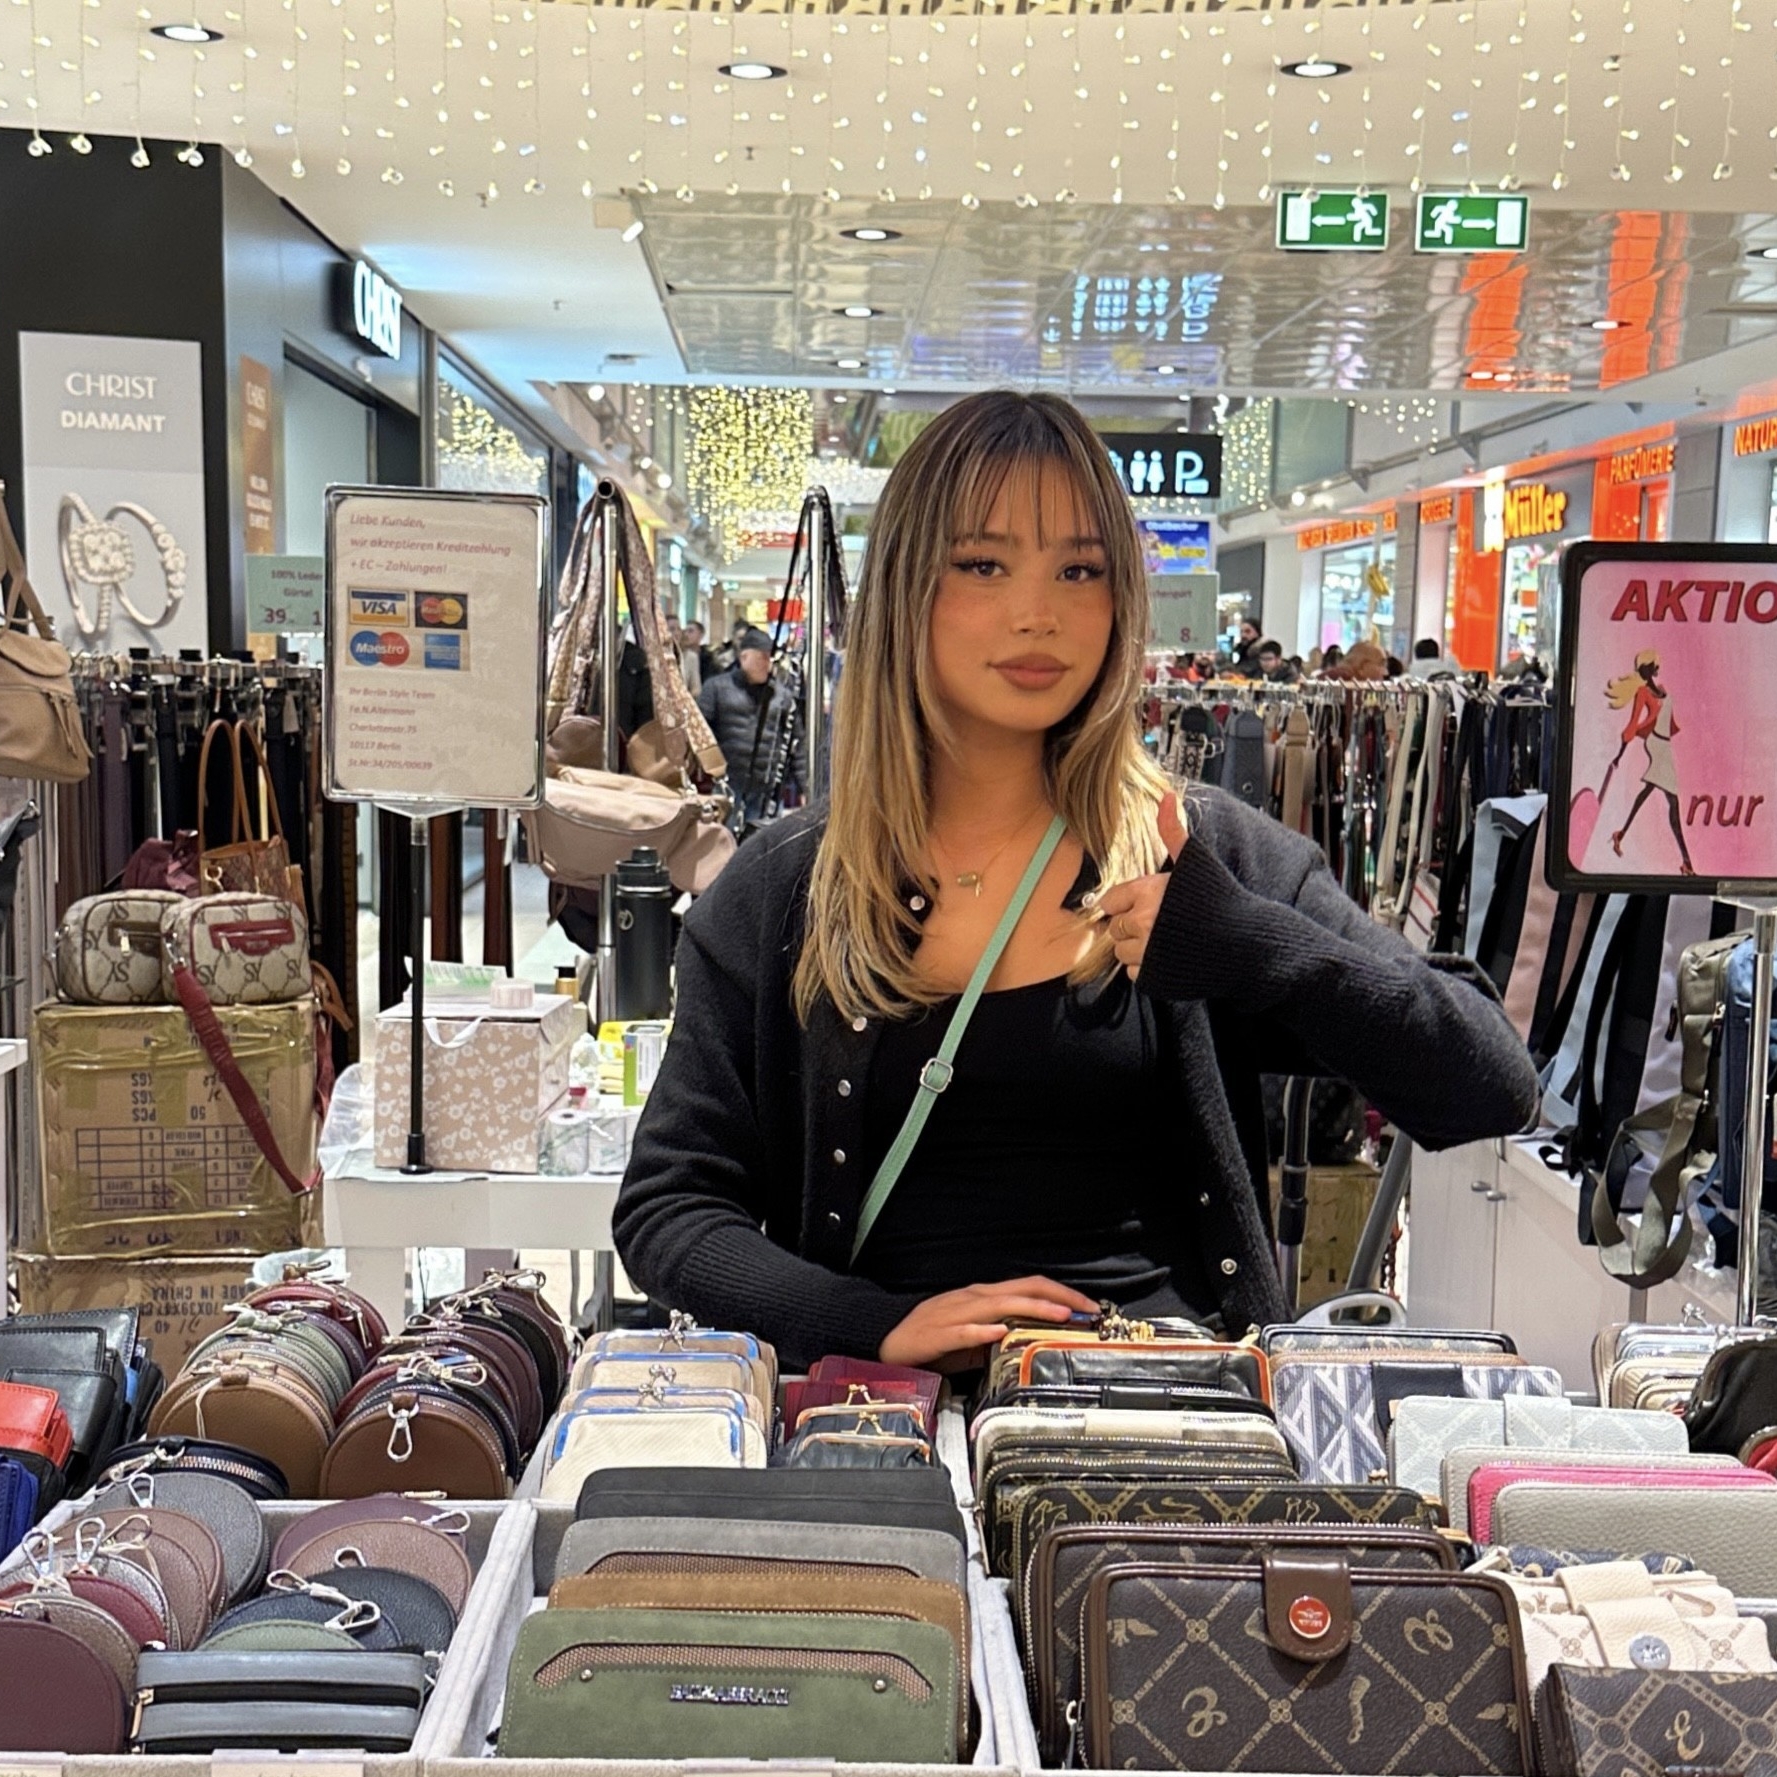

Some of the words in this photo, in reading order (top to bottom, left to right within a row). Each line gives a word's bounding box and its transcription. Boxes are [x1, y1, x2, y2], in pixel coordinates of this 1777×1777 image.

[354, 260, 402, 360] CHRIST
[65, 372, 158, 399] CHRIST
[61, 410, 166, 433] DIAMANT
[1610, 444, 1675, 484] PARFÜMERIE
[350, 514, 379, 525] Liebe
[381, 515, 426, 529] Kunden,
[1504, 483, 1567, 539] Müller
[350, 538, 368, 547] wir
[370, 537, 434, 551] akzeptieren
[437, 541, 512, 557] Kreditzahlung
[360, 559, 375, 570] EC
[385, 560, 448, 576] Zahlungen!
[361, 600, 398, 615] VISA
[1610, 579, 1777, 624] AKTIO
[355, 643, 405, 655] Maestro
[1686, 793, 1764, 827] nur
[132, 1108, 157, 1122] PCS
[190, 1105, 206, 1120] 50
[152, 1285, 193, 1301] CHINA
[201, 1285, 214, 1300] IN
[1150, 1639, 1190, 1682] COLLECTION
[1460, 1643, 1498, 1685] COLLECTION
[1227, 1658, 1271, 1702] COLLECTION
[1380, 1660, 1426, 1705] COLLECTION
